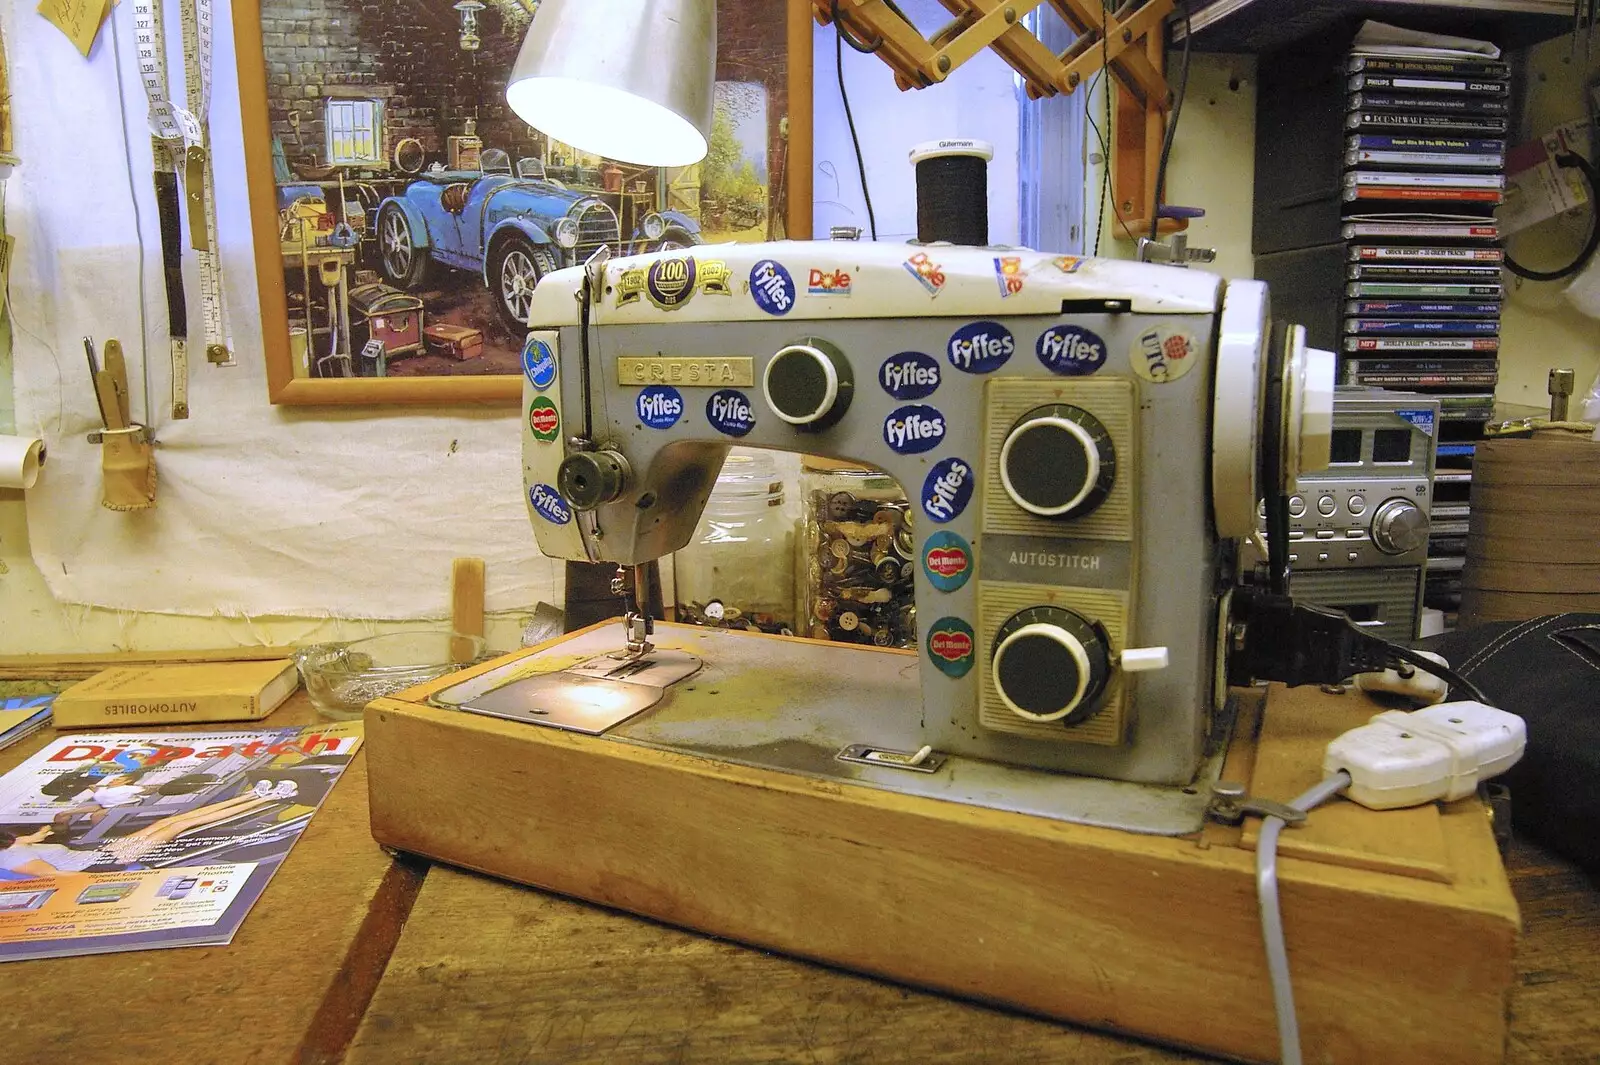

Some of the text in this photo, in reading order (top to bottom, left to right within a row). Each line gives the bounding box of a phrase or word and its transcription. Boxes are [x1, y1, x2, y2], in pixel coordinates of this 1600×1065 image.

[136, 20, 149, 28] 127
[142, 64, 154, 72] 130
[147, 79, 157, 87] 131
[1367, 78, 1390, 86] PHILIPS
[156, 107, 168, 115] 133
[809, 268, 851, 289] Dole
[632, 363, 735, 382] CRESTA
[928, 555, 966, 566] Del Monte
[1009, 551, 1100, 570] AUTOSTITCH
[933, 639, 970, 651] Del Monte
[104, 702, 197, 716] AUTOMOBILES
[163, 734, 263, 743] Community
[47, 733, 342, 769] Dispatch
[95, 876, 143, 884] Detectors
[25, 924, 76, 932] NOKIA
